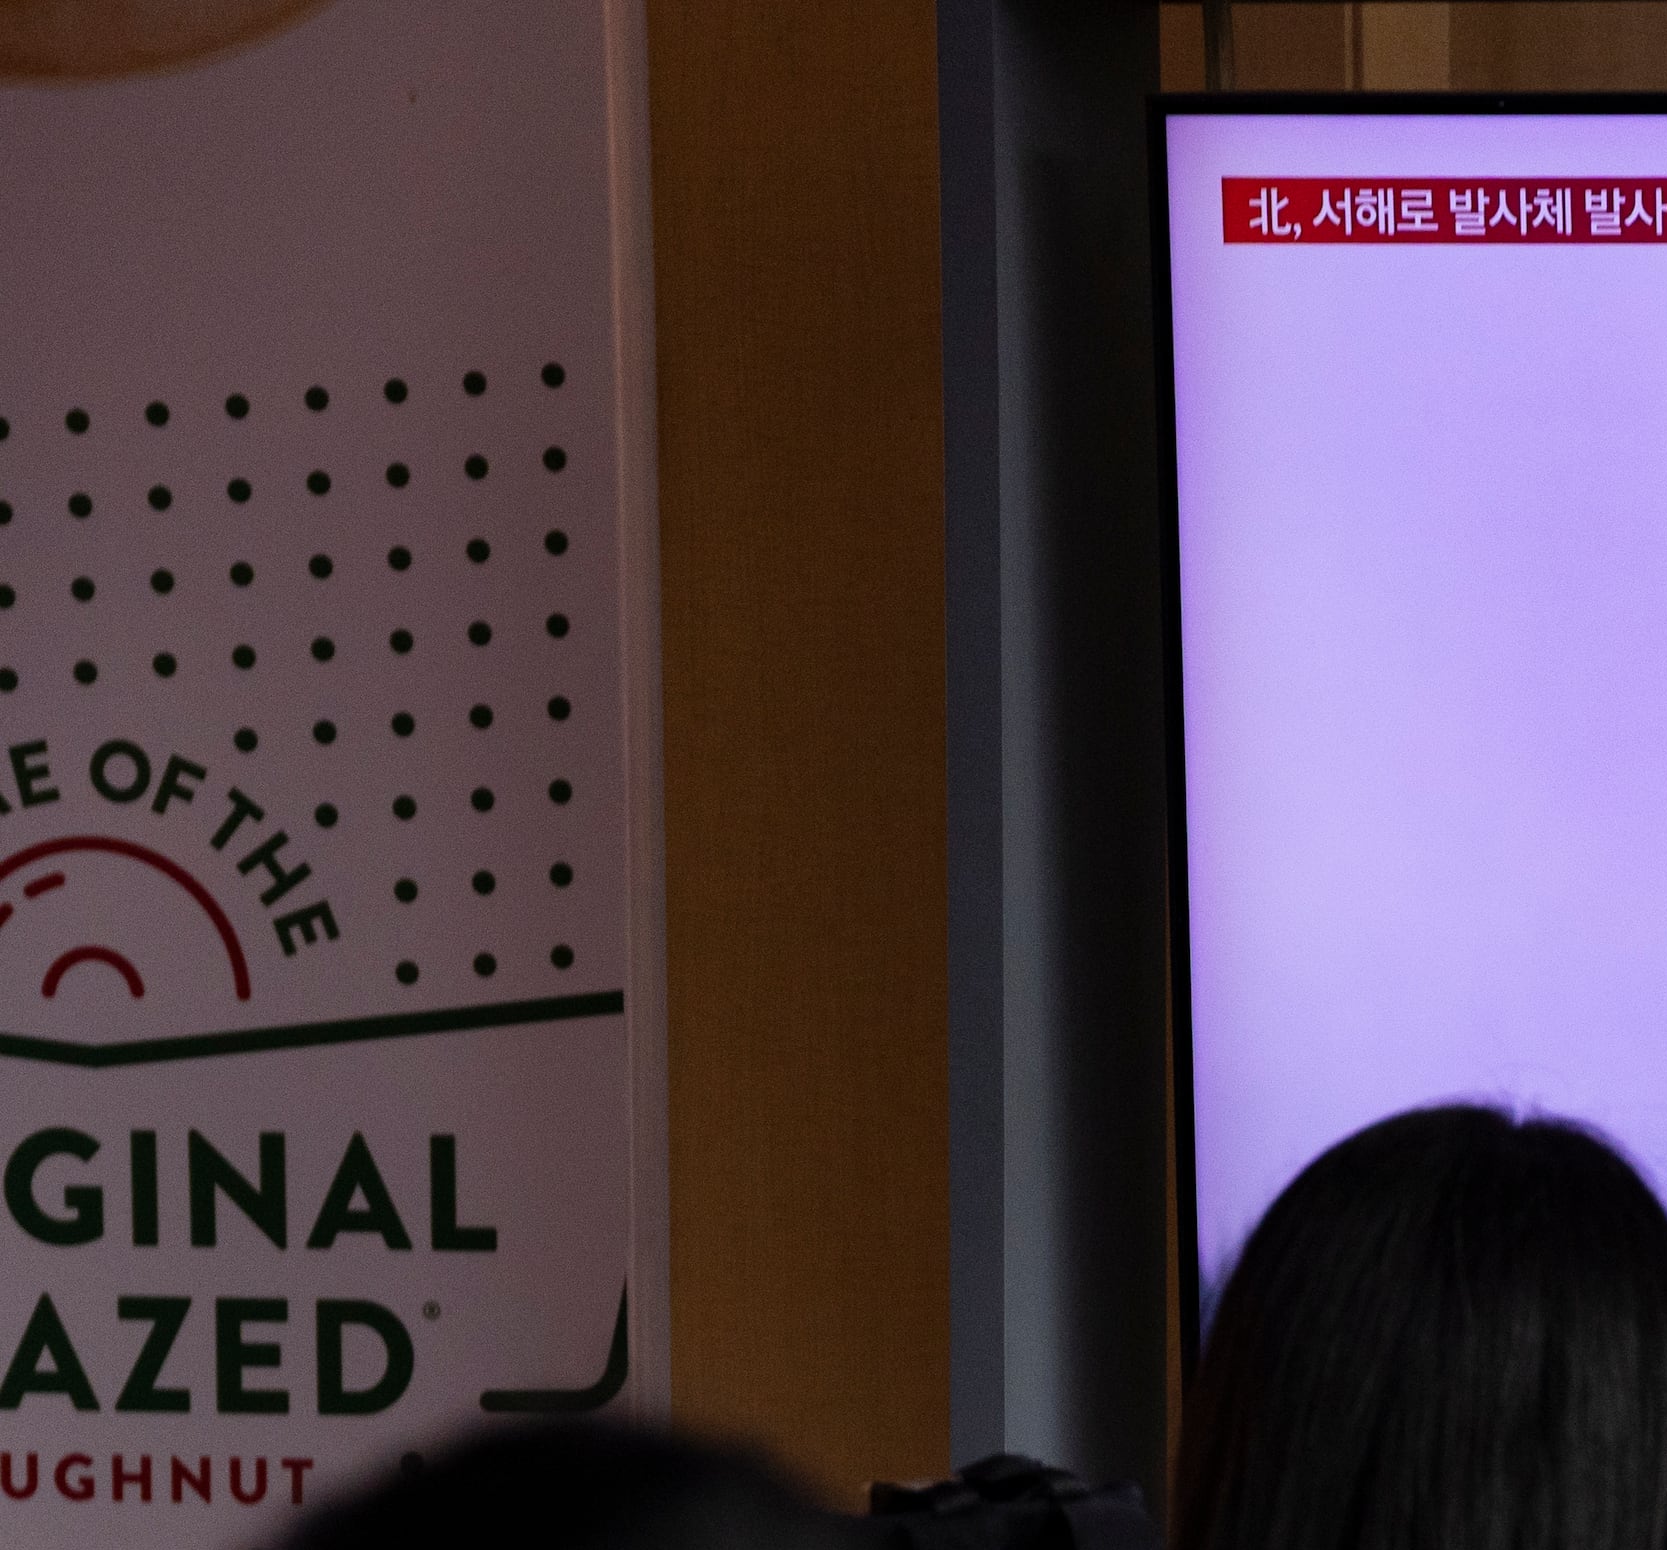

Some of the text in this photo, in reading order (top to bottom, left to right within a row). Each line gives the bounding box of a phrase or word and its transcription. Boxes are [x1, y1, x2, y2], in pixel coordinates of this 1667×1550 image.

[1249, 187, 1301, 241] 北,
[1313, 187, 1438, 236] 서해로
[1450, 187, 1573, 236] 발사체
[0, 739, 341, 958] E OF THE
[3, 1125, 499, 1252] GINAL
[0, 1451, 314, 1507] UGHNUT
